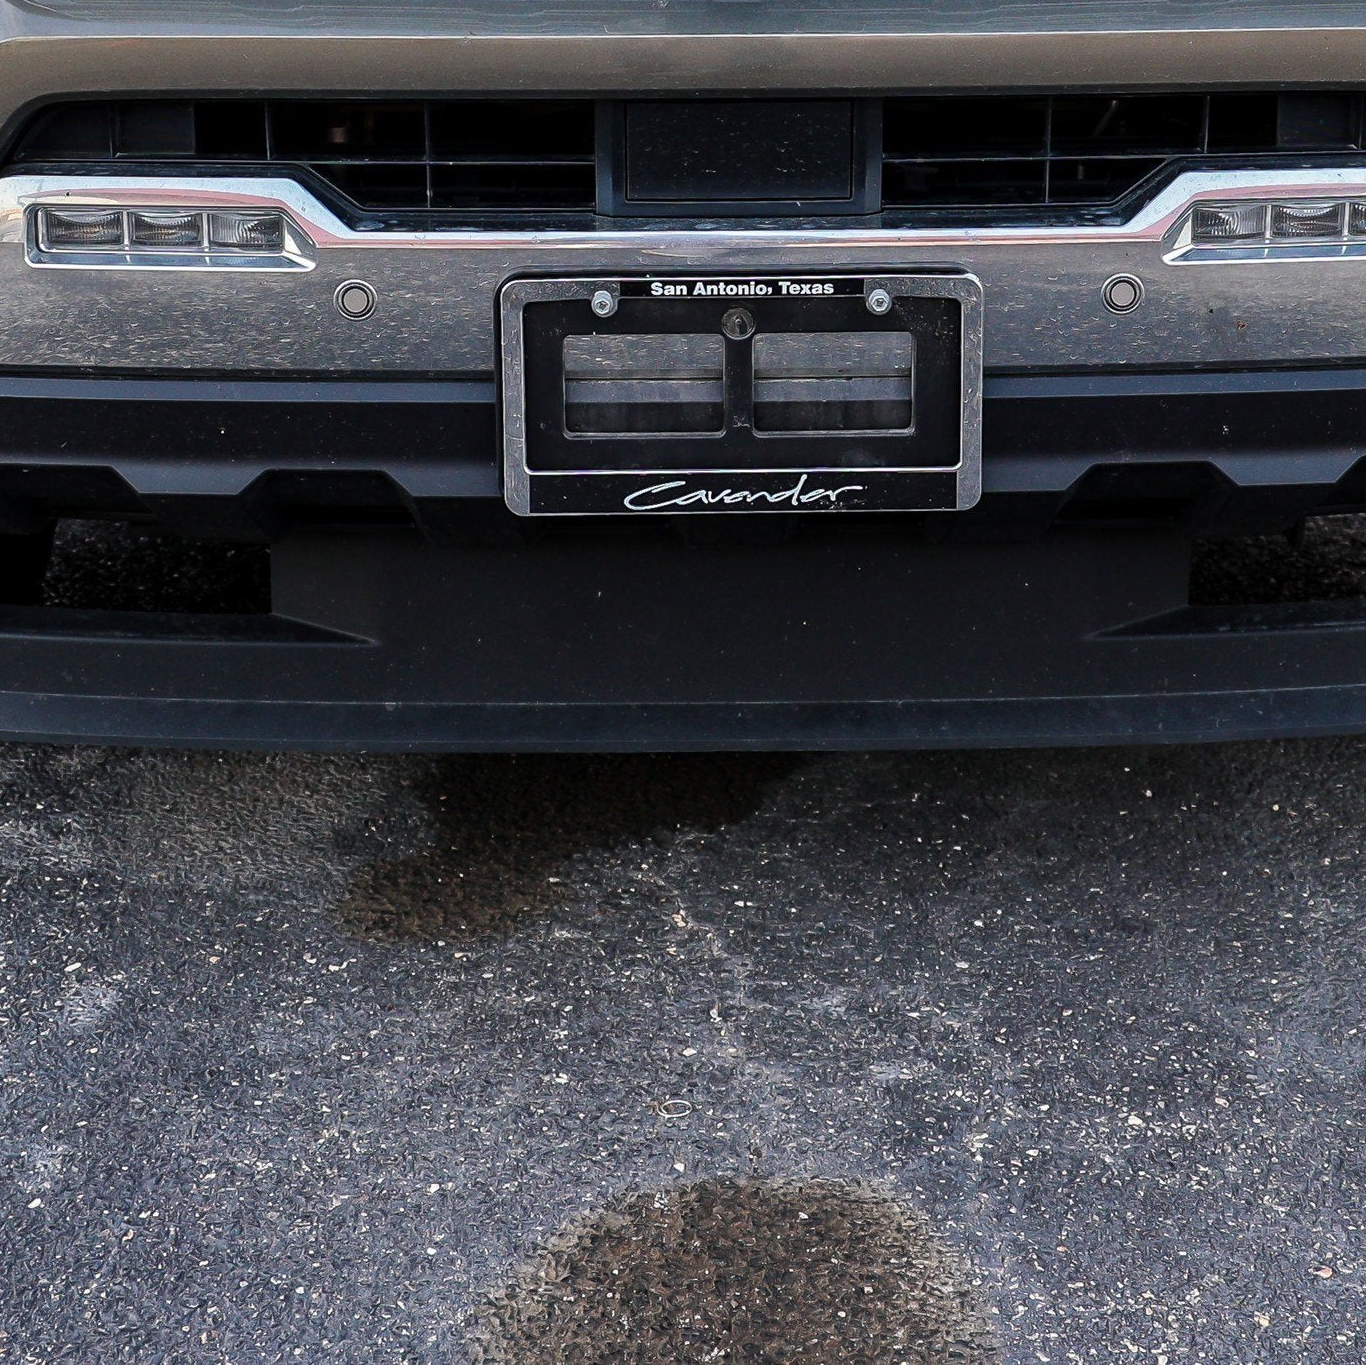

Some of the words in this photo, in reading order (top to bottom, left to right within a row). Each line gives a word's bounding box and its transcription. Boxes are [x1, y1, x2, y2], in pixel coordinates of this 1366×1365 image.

[650, 282, 687, 296] San
[692, 281, 773, 296] Antonio,
[778, 281, 835, 295] Texas
